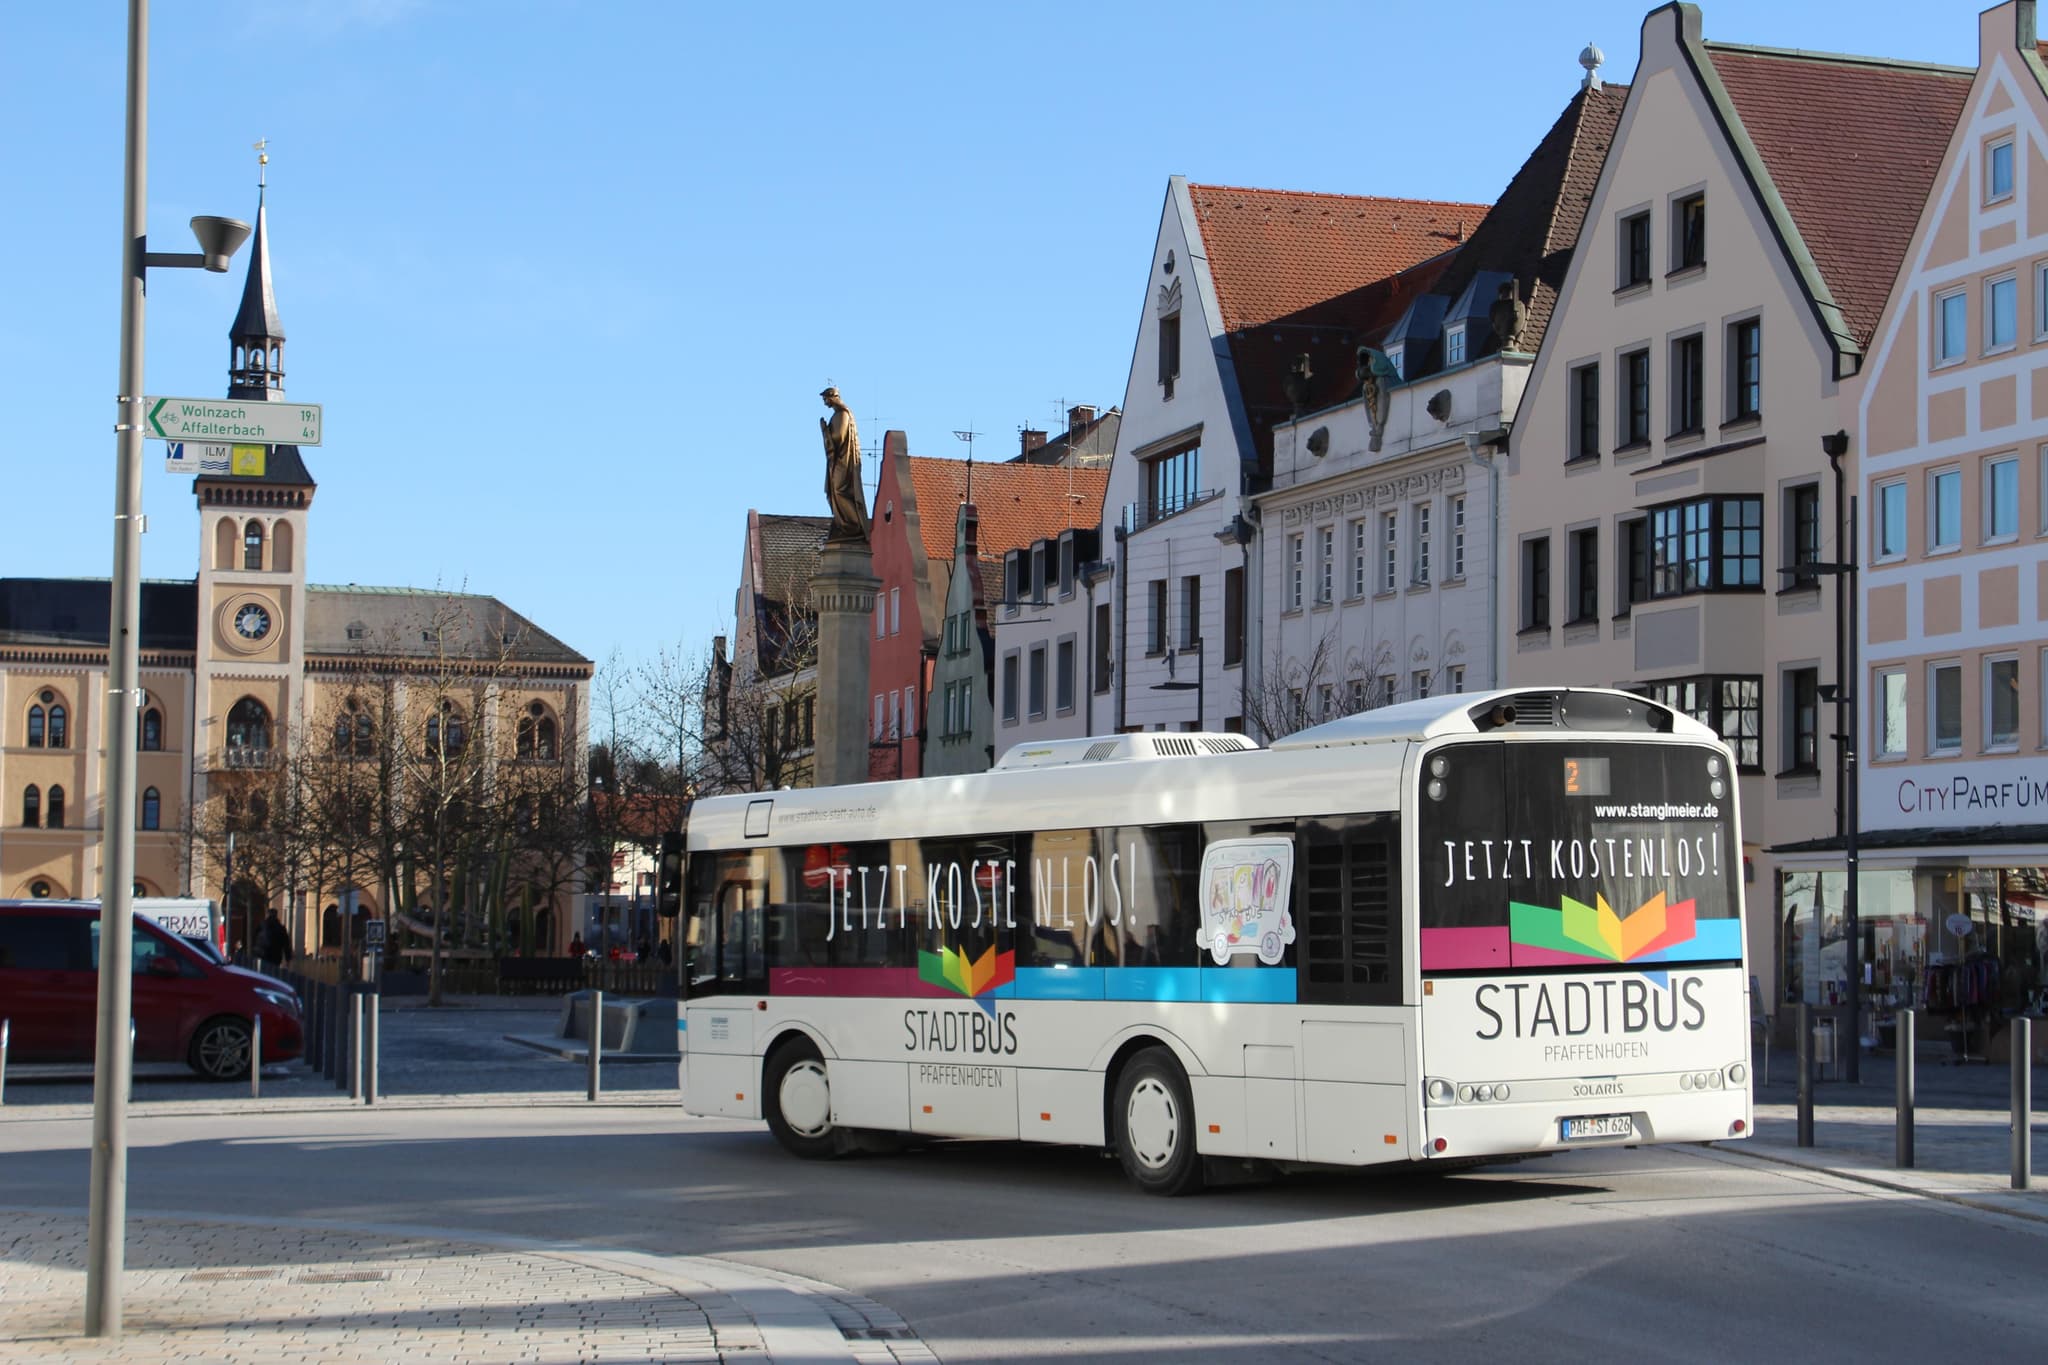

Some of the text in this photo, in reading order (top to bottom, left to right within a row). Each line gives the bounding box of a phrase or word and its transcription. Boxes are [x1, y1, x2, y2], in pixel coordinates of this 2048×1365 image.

[181, 405, 246, 419] Wolnzach
[181, 421, 265, 437] Affalterbach
[205, 446, 226, 457] ILM
[1566, 760, 1579, 792] 2
[1595, 803, 1719, 820] www.stanglmeier.de
[1444, 832, 1719, 887] JETZT KOSTENLOS!
[826, 864, 907, 942] JETZT
[1475, 976, 1706, 1041] STADTBUS
[904, 1010, 1018, 1055] STADTBUS
[1544, 1041, 1649, 1062] PFAFFENHOFEN
[920, 1065, 1002, 1088] PFAFFENHOFEN
[1573, 1083, 1624, 1096] SOLARIS
[1570, 1118, 1630, 1135] PAF ST 626
